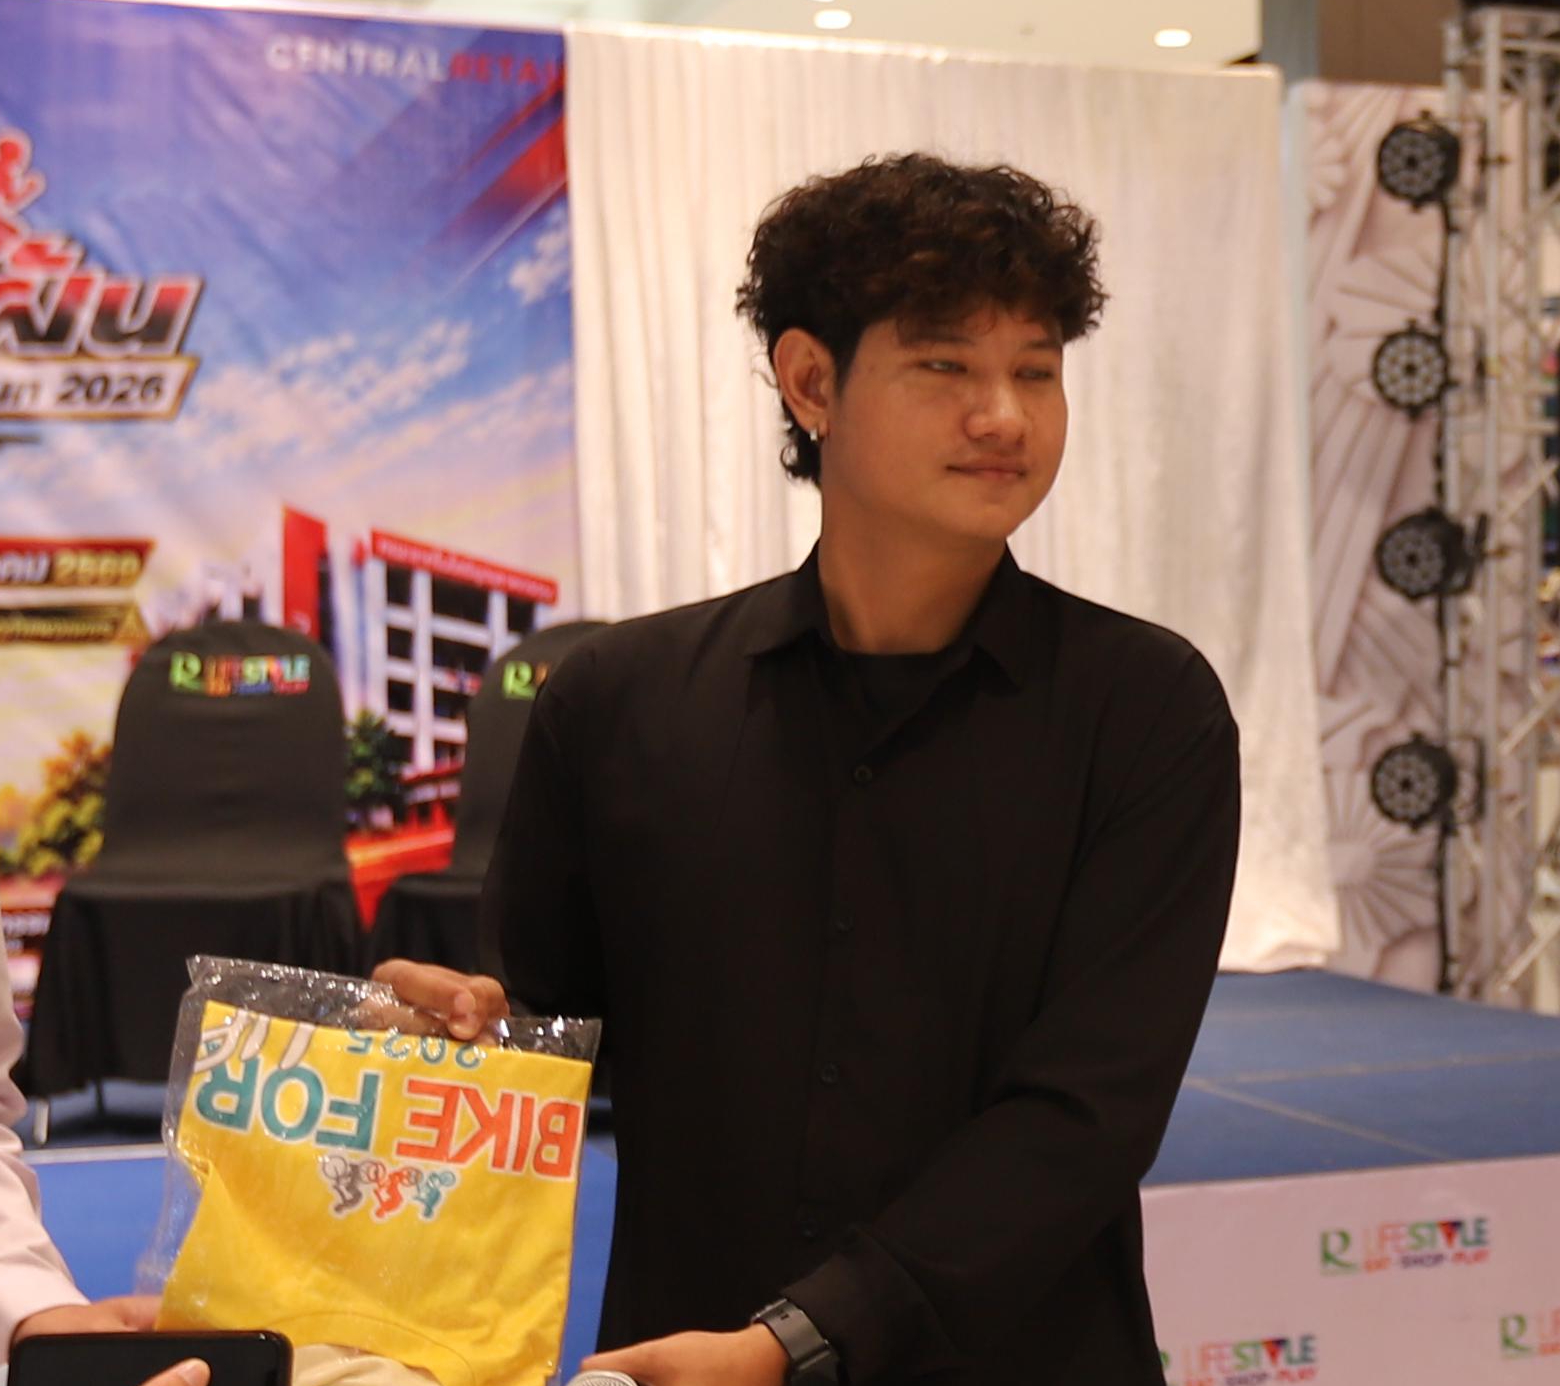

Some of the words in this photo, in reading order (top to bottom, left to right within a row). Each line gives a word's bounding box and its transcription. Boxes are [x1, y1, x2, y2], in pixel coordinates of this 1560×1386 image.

[55, 370, 164, 406] 2026
[195, 1057, 381, 1151] FOR
[395, 1077, 584, 1179] BIKE
